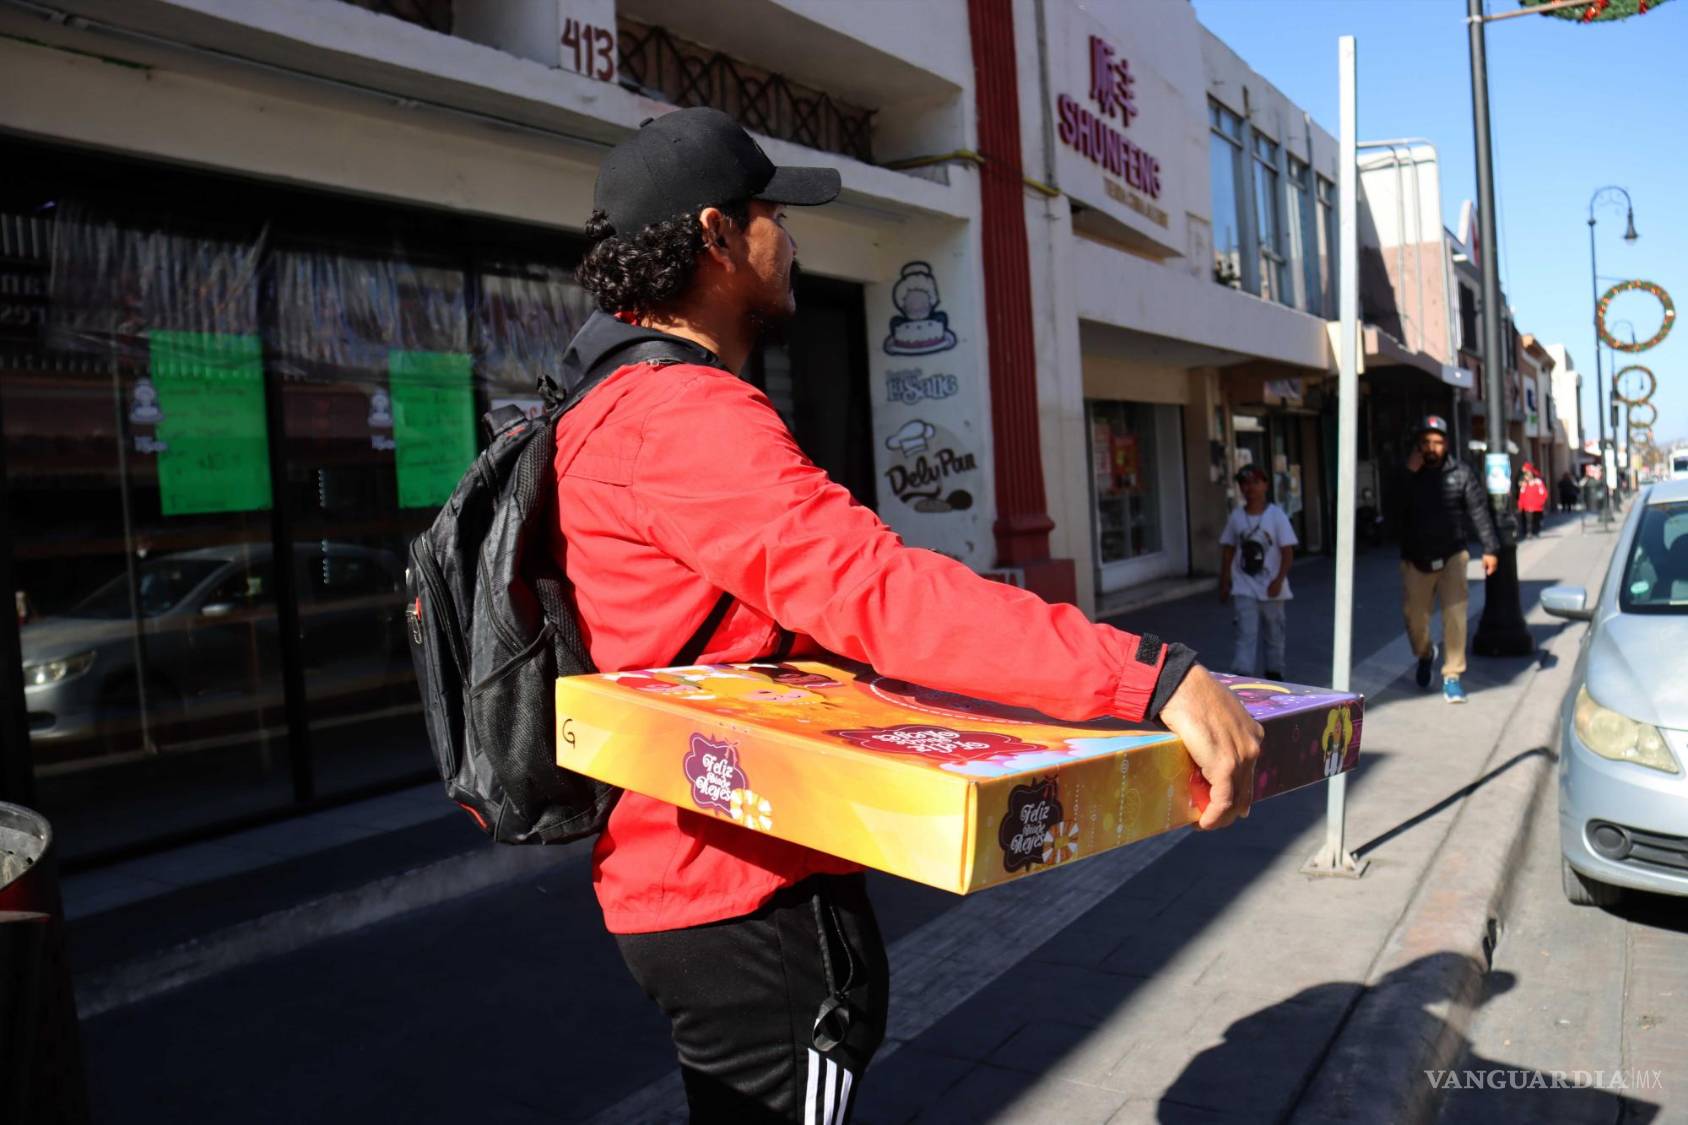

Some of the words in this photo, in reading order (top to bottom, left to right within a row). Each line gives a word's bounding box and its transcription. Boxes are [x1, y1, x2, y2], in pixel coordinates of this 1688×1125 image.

[560, 17, 614, 81] 413
[1056, 93, 1162, 200] SHUNFENG
[702, 753, 733, 779] Feliz
[695, 776, 733, 801] Reyes
[1020, 800, 1050, 824] Feliz
[1010, 834, 1045, 854] Reyes
